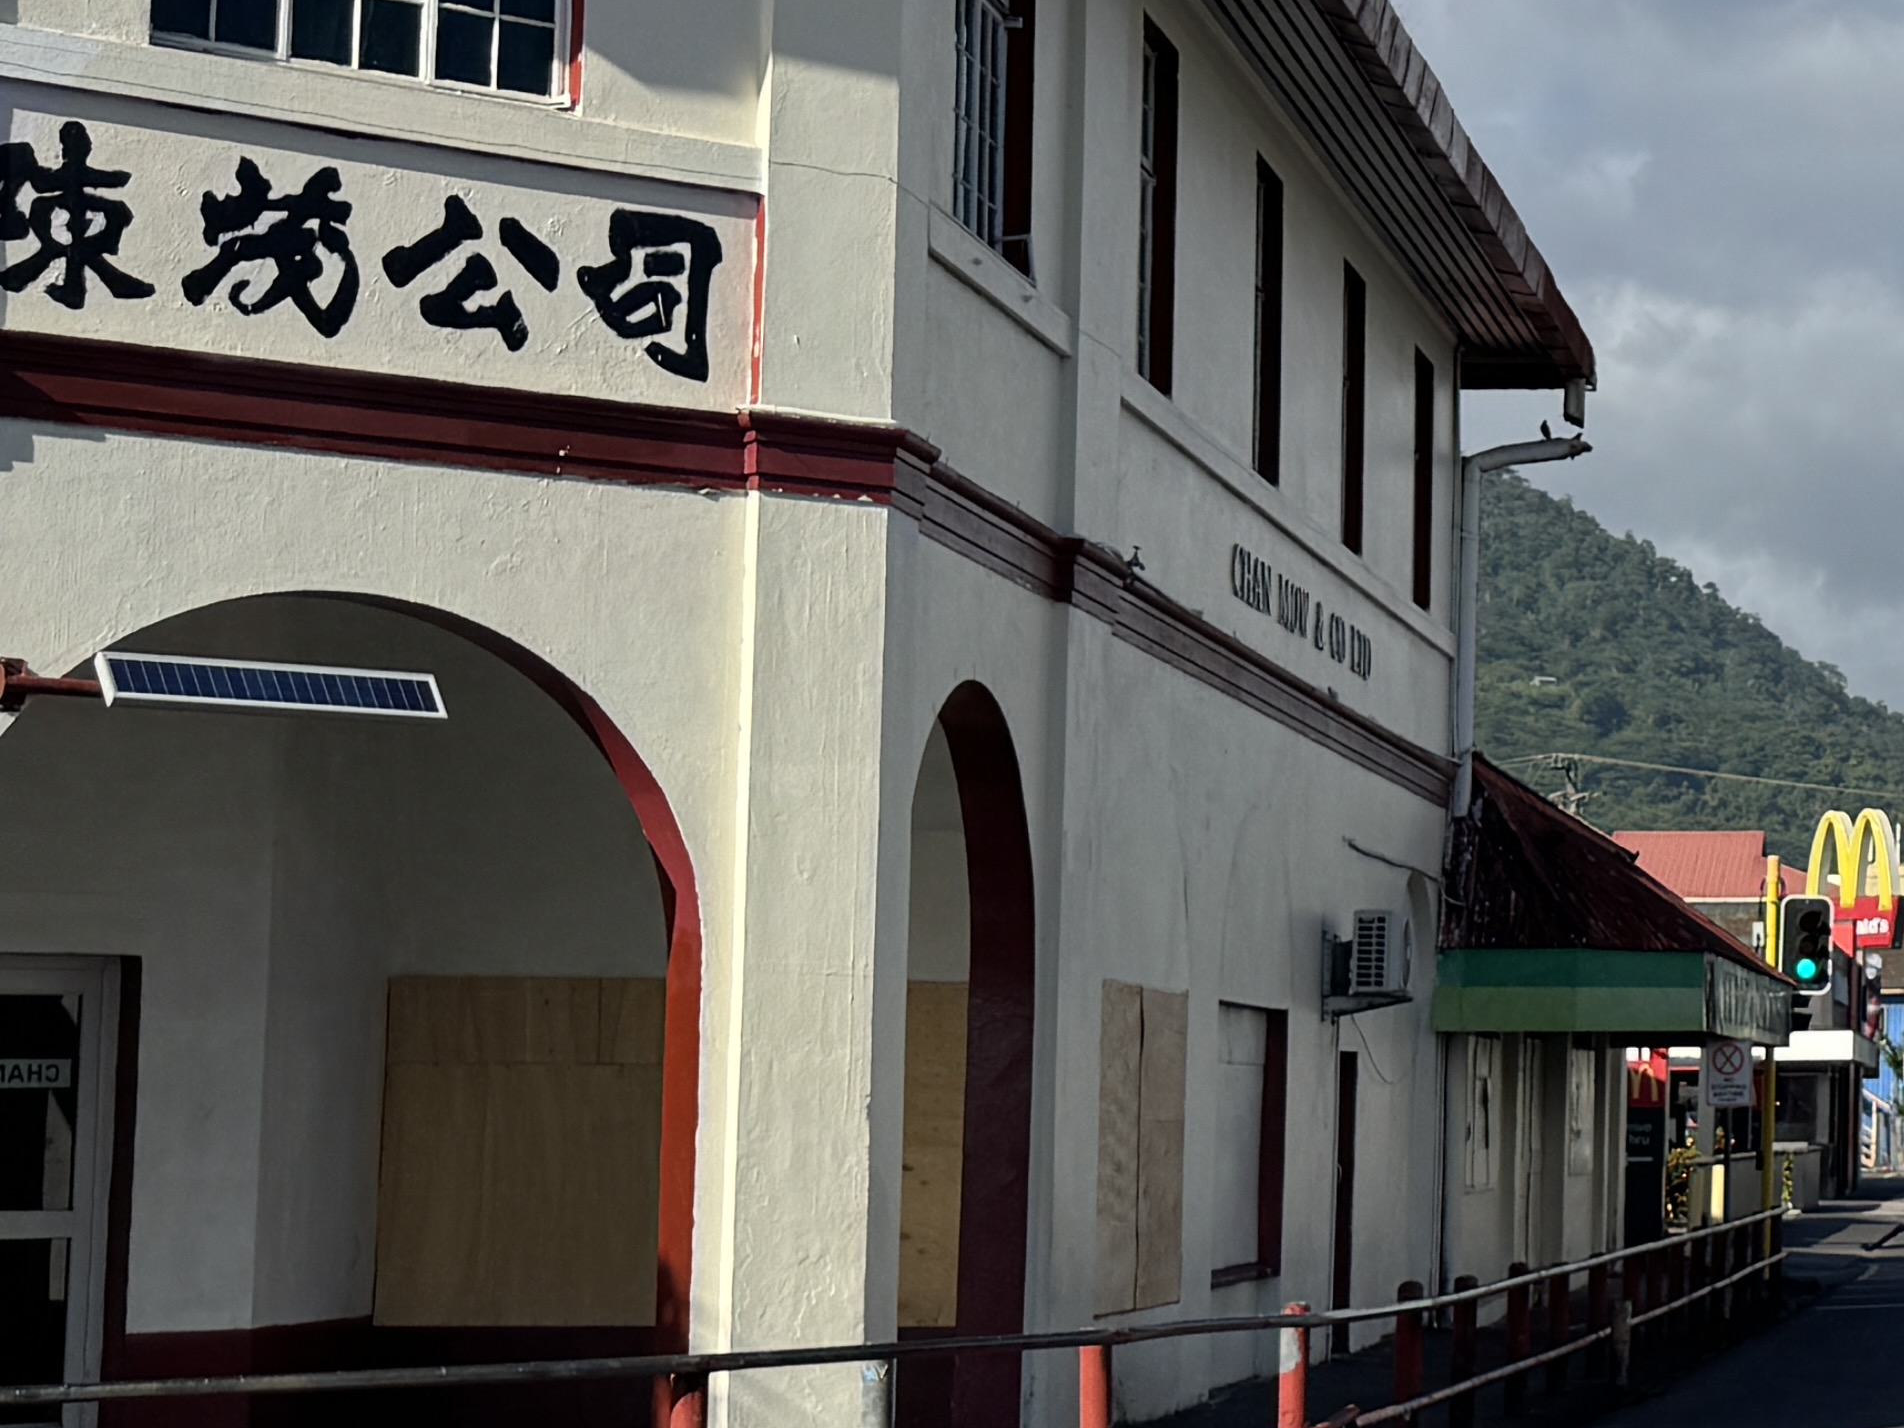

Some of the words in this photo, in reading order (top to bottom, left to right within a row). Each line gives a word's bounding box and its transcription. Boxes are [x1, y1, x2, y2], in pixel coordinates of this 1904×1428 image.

[1231, 543, 1272, 616] CHAN
[1277, 573, 1309, 639] MOW
[1314, 600, 1324, 651] &
[1350, 624, 1371, 681] LTD
